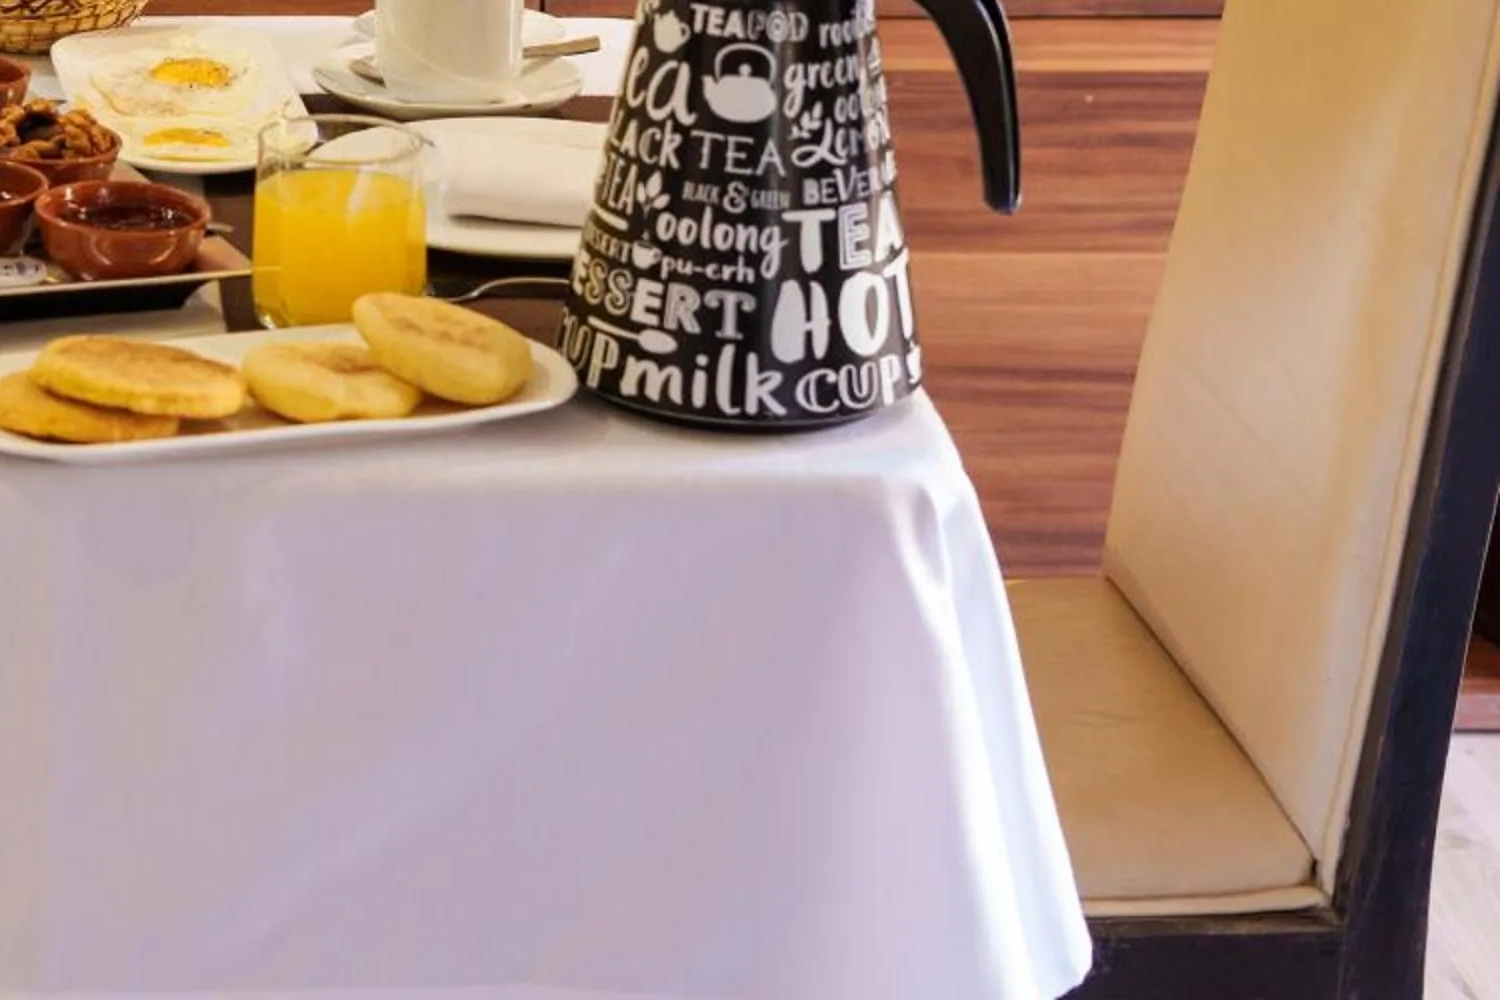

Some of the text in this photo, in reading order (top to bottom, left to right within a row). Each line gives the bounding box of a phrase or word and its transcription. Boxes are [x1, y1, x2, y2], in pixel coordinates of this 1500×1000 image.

[626, 46, 698, 126] ea
[690, 129, 786, 177] TEA
[722, 181, 749, 214] &
[781, 190, 903, 275] TEA
[656, 205, 789, 280] oolong
[572, 249, 757, 341] ESSERT
[771, 247, 915, 364] HOT
[619, 343, 788, 417] milk
[795, 353, 902, 414] CUP
